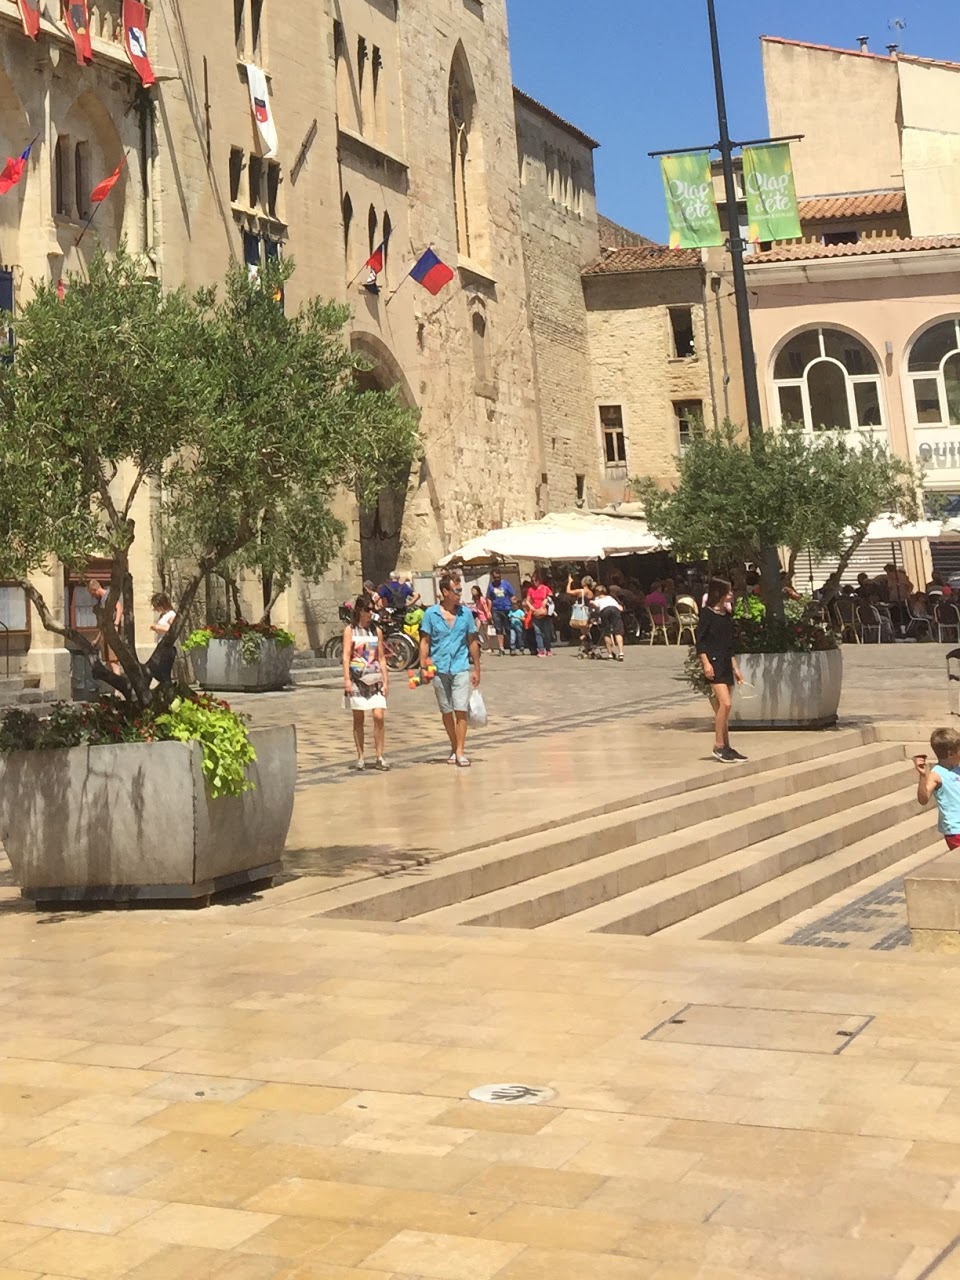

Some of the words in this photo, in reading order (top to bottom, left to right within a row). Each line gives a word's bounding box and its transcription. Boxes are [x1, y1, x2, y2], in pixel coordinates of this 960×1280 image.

[669, 180, 710, 202] Clap
[747, 172, 791, 195] Clap
[676, 199, 711, 219] 'été
[919, 442, 960, 463] QUI
